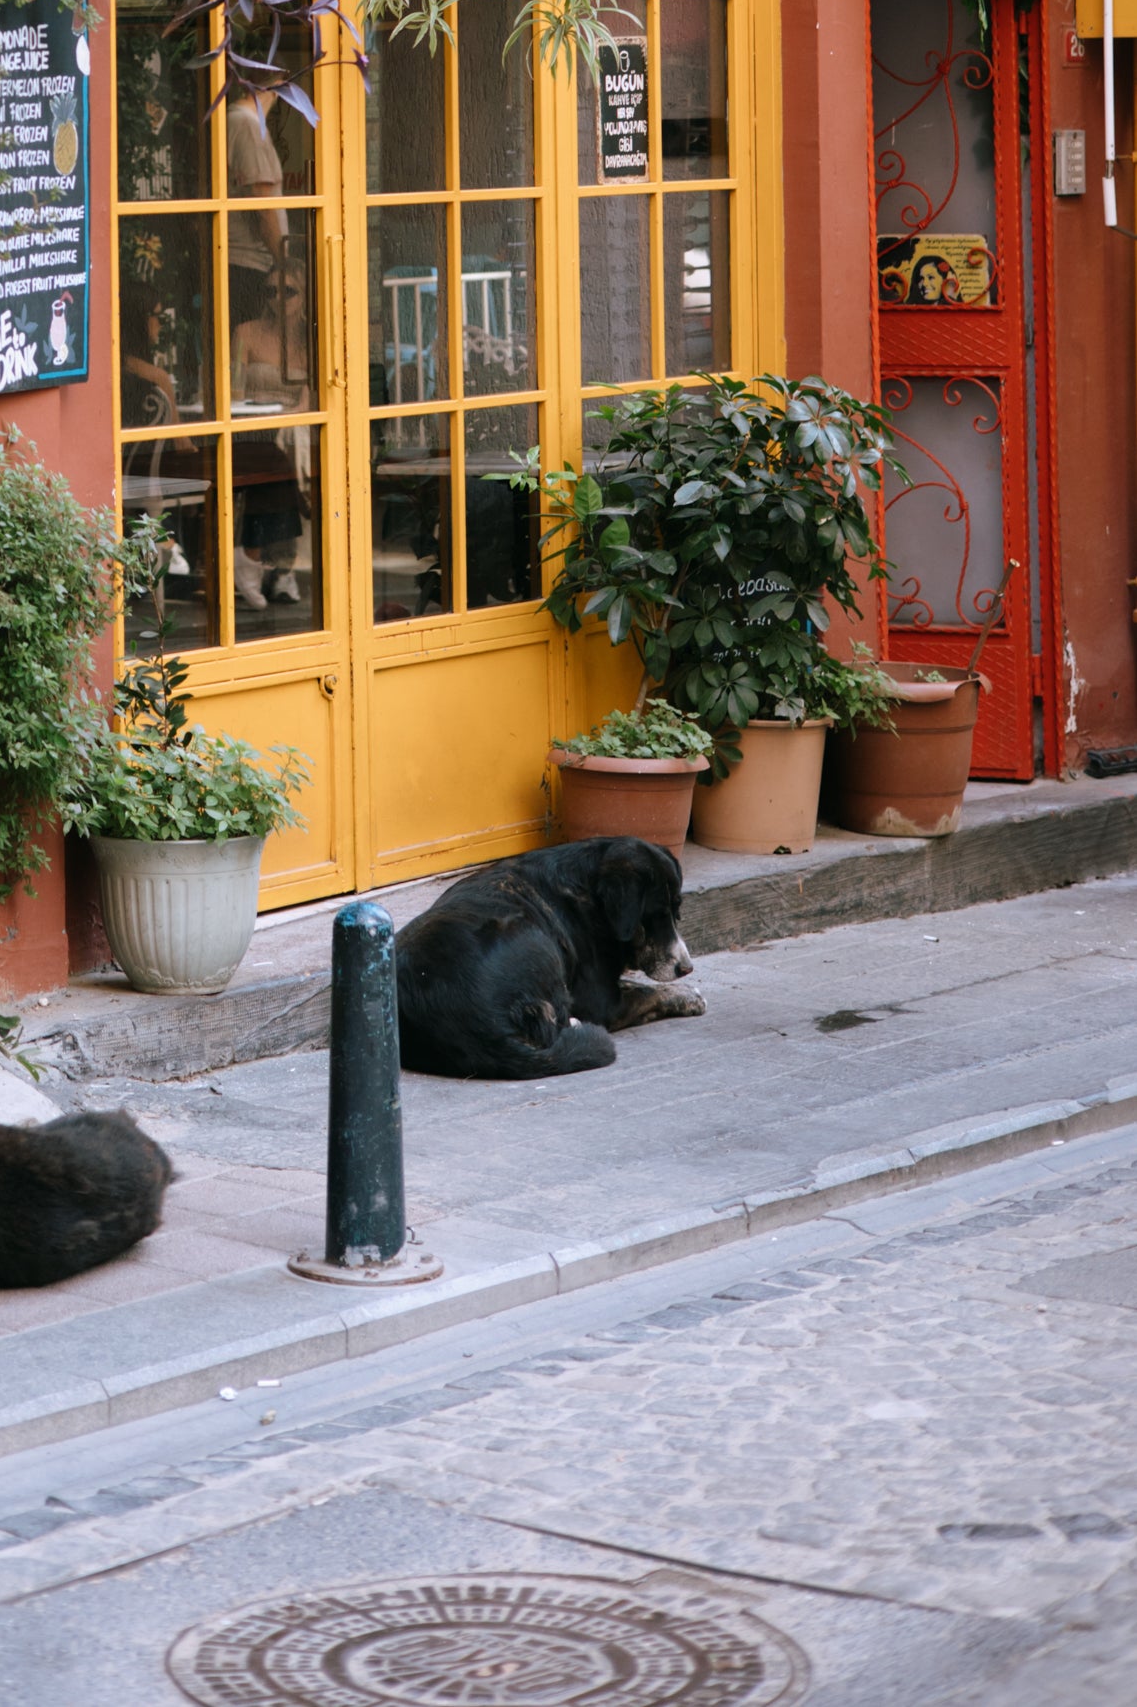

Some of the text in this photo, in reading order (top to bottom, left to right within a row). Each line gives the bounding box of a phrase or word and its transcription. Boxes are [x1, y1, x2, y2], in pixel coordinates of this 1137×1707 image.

[22, 51, 50, 71] JUICE
[41, 75, 75, 96] FROZEN
[605, 70, 644, 92] BUGÜN
[9, 101, 42, 121] FROZEN
[13, 125, 48, 144] FROZEN
[17, 150, 50, 167] FROZEN
[13, 176, 38, 193] FRUIT
[39, 175, 76, 192] FROZEN
[31, 227, 80, 247] MILKSHAKE
[28, 249, 78, 269] MILKSHAKE
[5, 278, 31, 298] FOREST
[32, 276, 53, 293] FRUIT
[54, 272, 87, 289] MILKSHAKE
